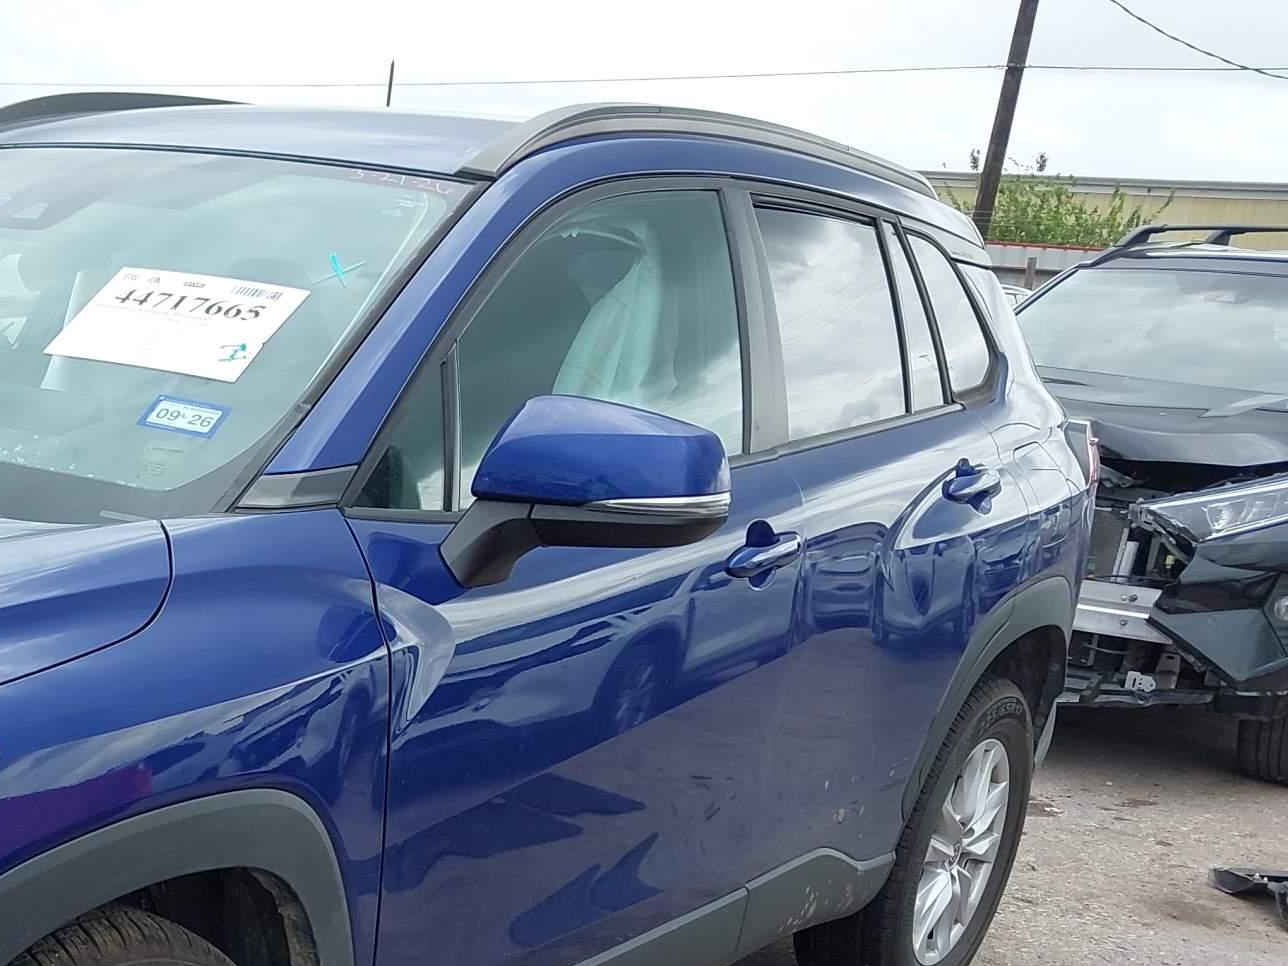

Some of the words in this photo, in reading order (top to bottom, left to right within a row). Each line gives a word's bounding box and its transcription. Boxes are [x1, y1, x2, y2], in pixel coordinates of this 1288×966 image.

[115, 289, 267, 321] 44717665
[156, 408, 181, 421] 09
[187, 414, 214, 427] 26
